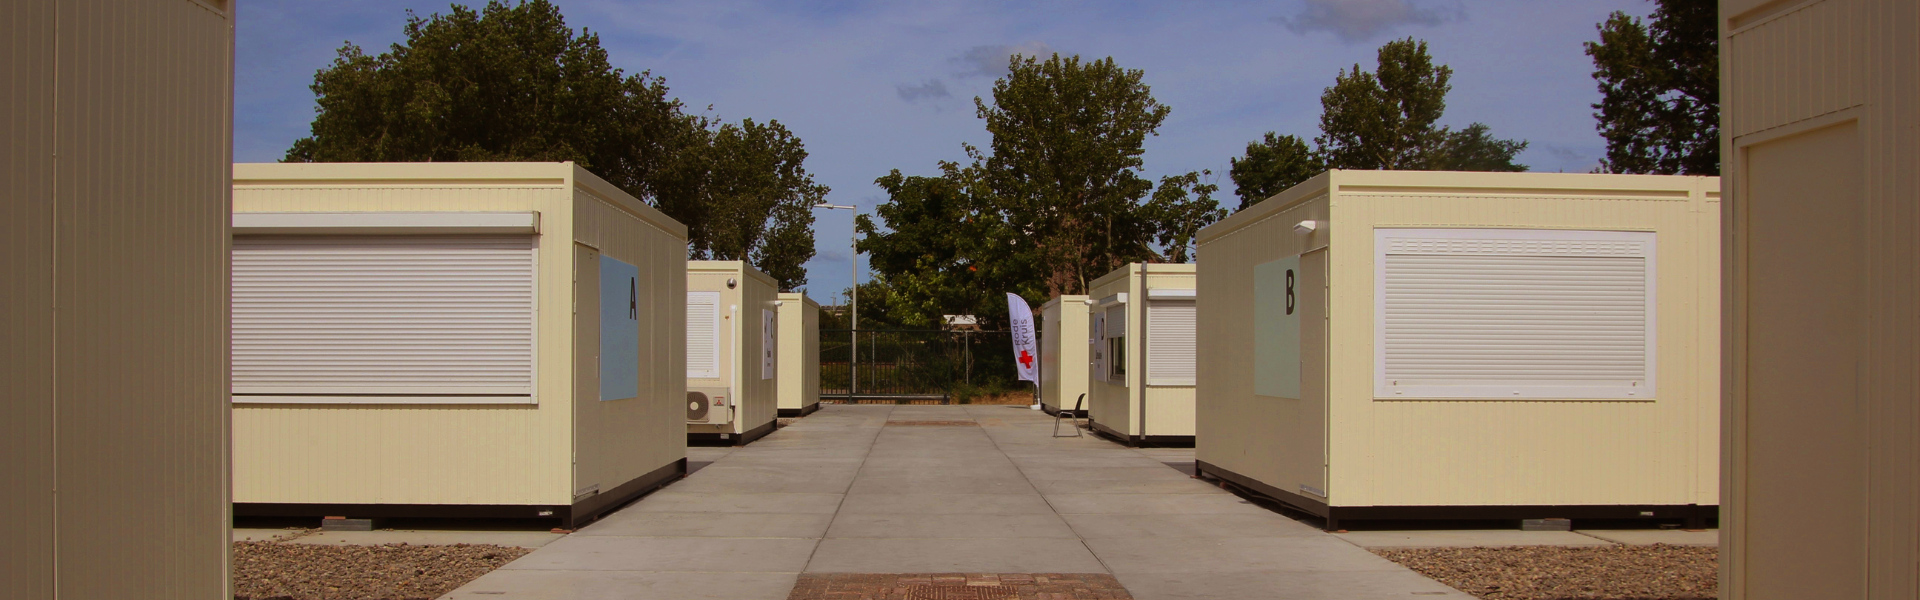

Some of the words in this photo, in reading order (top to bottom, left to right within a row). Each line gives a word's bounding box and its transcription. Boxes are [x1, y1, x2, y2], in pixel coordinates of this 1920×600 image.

[630, 276, 636, 320] A
[1286, 268, 1295, 315] B
[1012, 319, 1020, 345] Rode
[1020, 319, 1030, 345] Kruis
